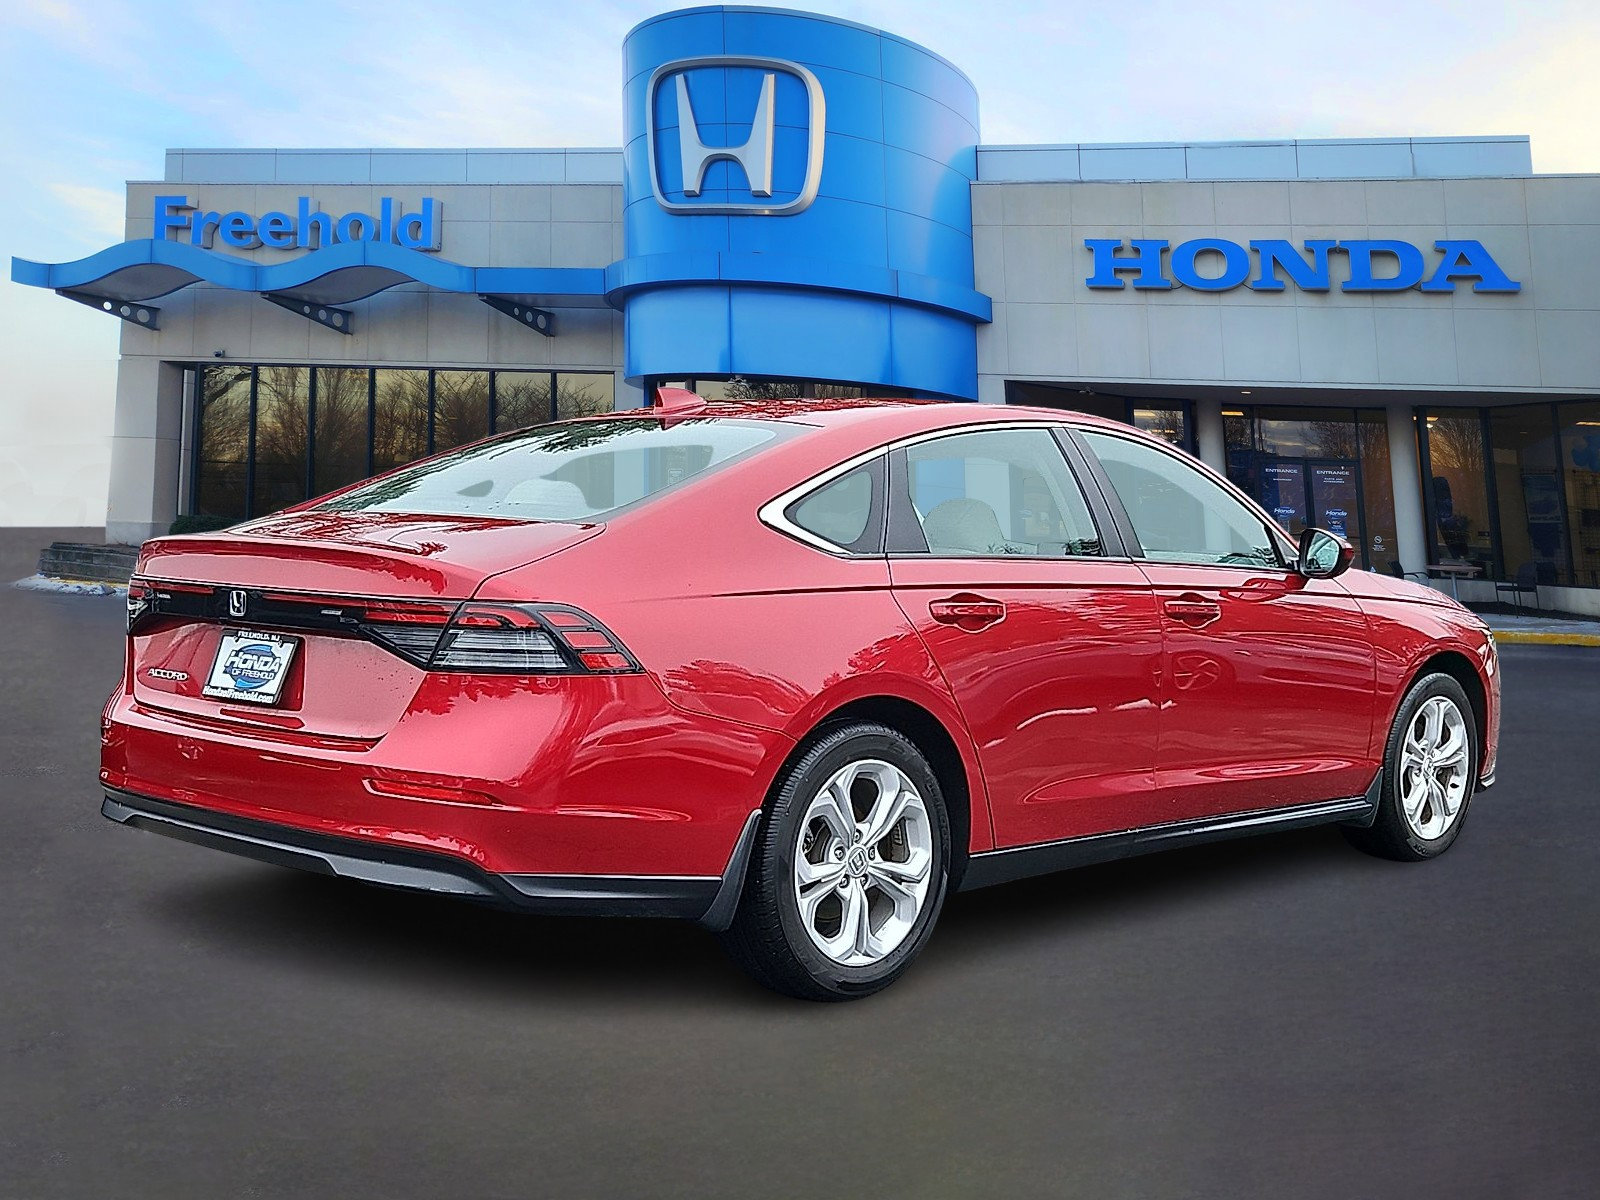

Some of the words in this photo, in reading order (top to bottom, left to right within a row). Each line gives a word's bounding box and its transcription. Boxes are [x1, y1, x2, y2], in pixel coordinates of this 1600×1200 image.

[154, 195, 440, 250] Freehold
[1084, 238, 1522, 294] HONDA
[225, 650, 281, 672] HONDA
[147, 668, 188, 681] ACCORD
[231, 668, 241, 676] OF
[241, 669, 274, 680] FREEHOLD
